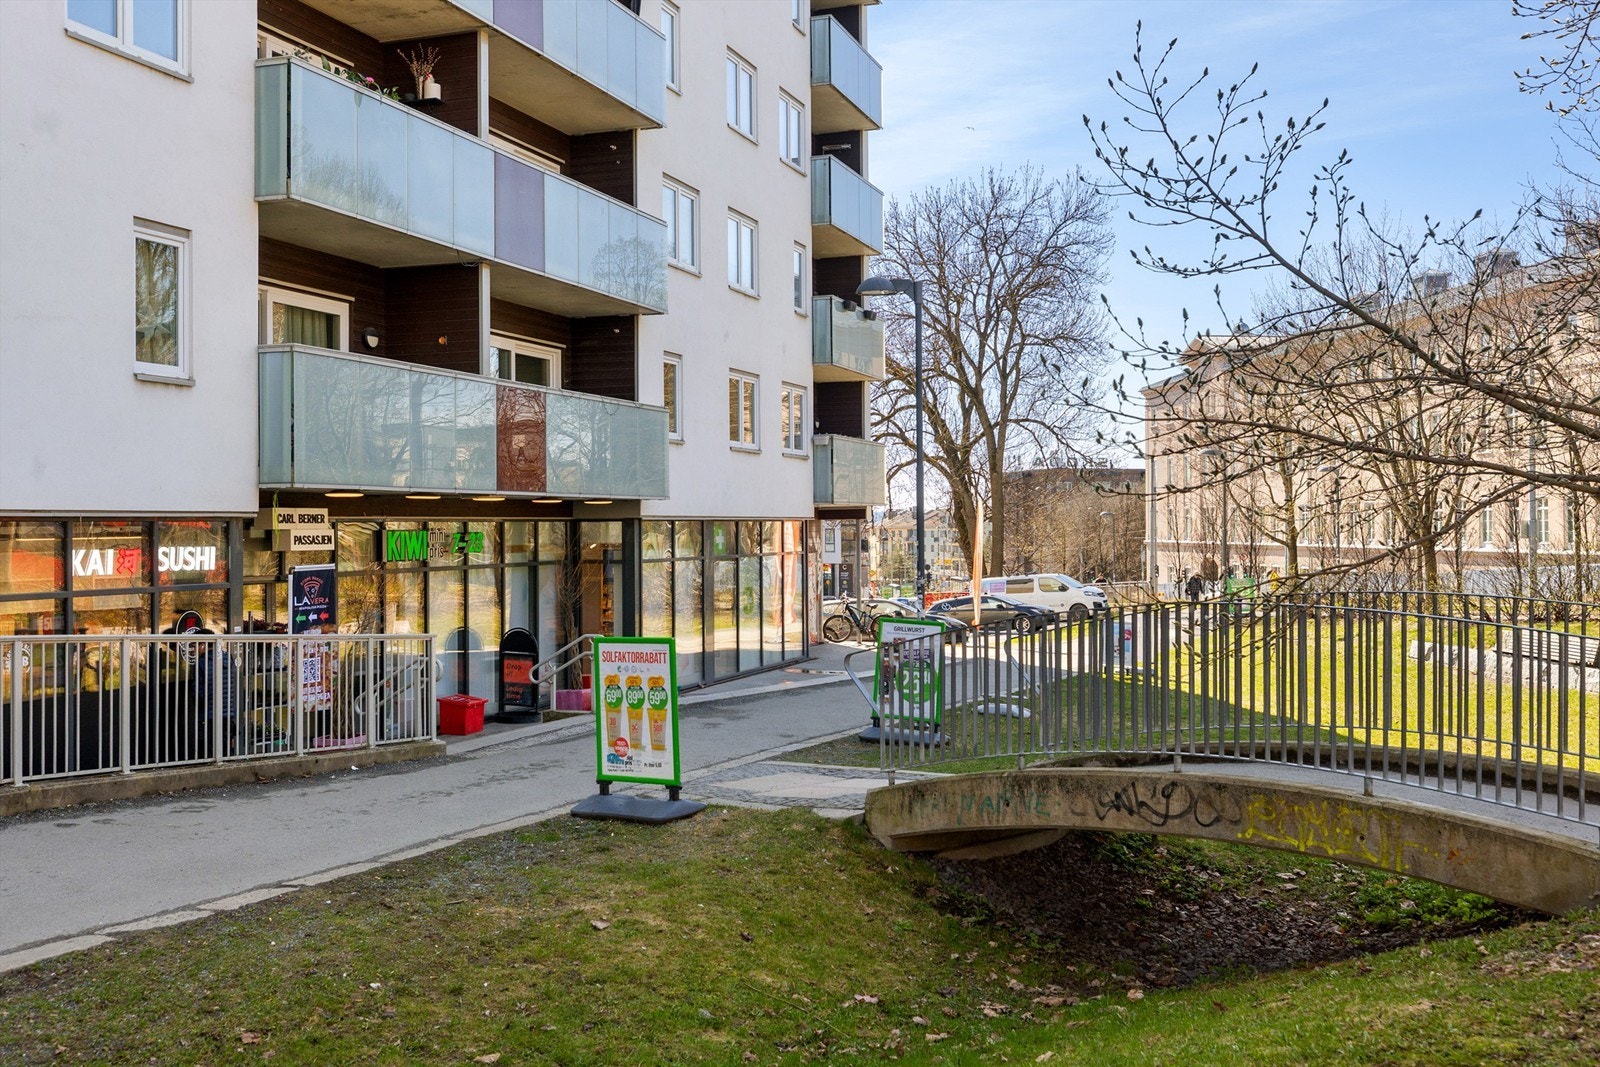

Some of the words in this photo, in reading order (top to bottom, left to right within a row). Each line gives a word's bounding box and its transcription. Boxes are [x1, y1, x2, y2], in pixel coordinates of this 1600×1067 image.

[277, 513, 296, 524] CARL
[298, 513, 326, 524] BERNER
[293, 534, 333, 546] PASSASJEN
[387, 529, 428, 562] KIWI
[72, 549, 115, 576] KAI
[158, 546, 216, 571] SUSHI
[893, 625, 926, 634] GRILLWURST
[601, 651, 667, 664] SOLFAKTORRABATT
